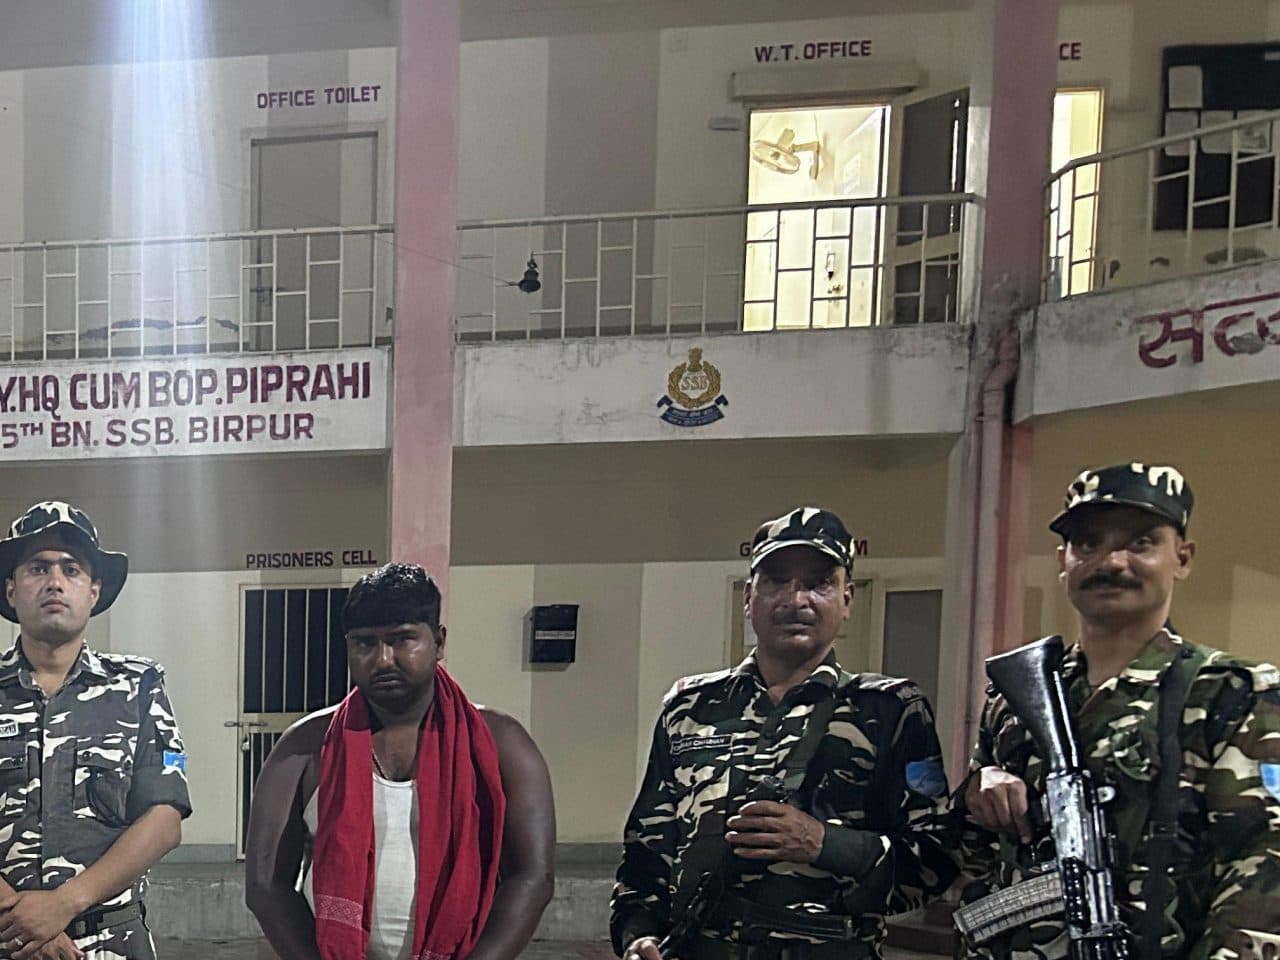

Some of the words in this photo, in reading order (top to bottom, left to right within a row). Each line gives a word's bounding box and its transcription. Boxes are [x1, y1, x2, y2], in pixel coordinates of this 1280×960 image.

[257, 89, 315, 109] OFFICE
[324, 85, 381, 105] TOILET
[70, 371, 141, 411] CUM
[188, 412, 314, 444] BIRPUR
[246, 551, 334, 568] PRISONERS
[342, 550, 377, 565] CELL
